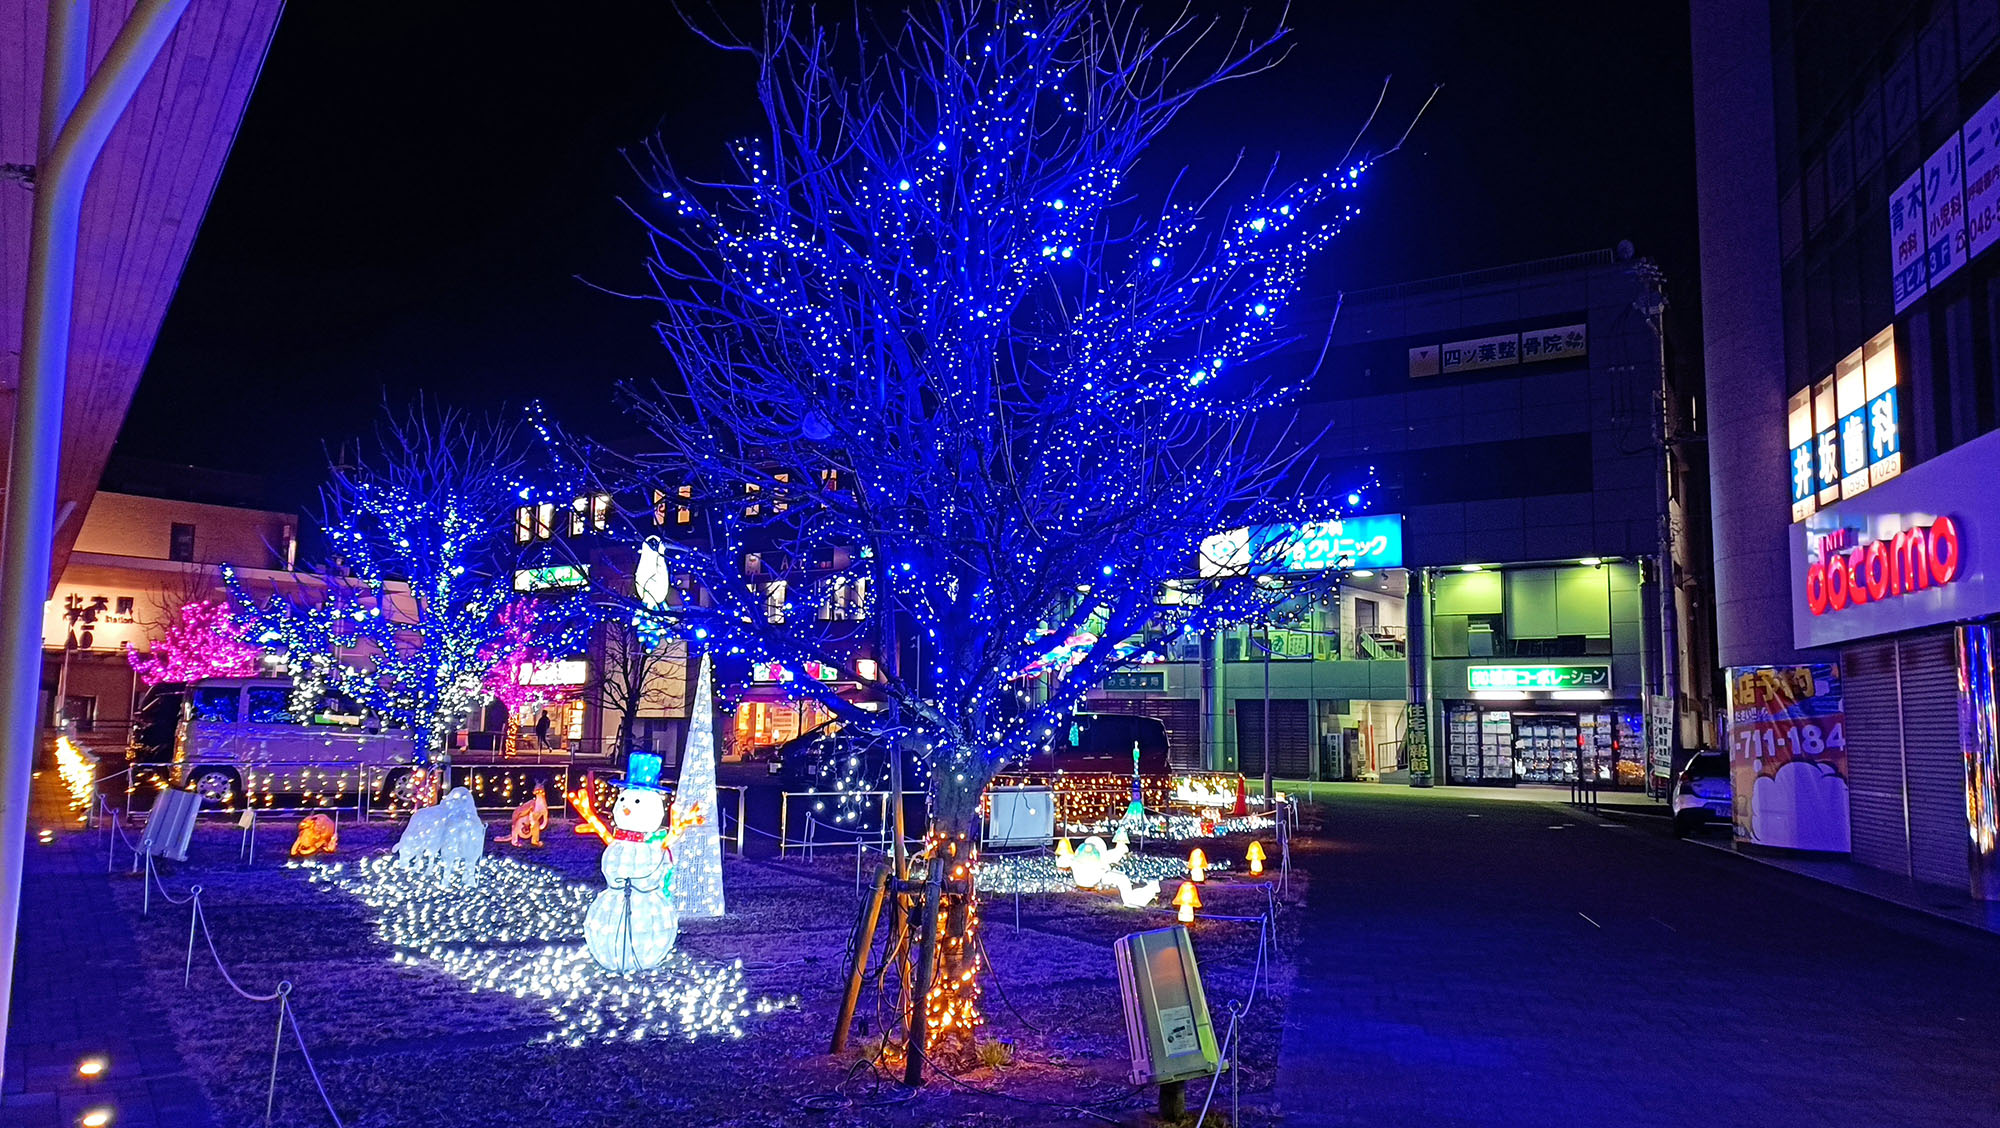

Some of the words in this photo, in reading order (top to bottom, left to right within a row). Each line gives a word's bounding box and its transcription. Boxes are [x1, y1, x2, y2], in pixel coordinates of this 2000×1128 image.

[1930, 191, 1961, 238] 小児科
[1444, 334, 1562, 367] 四ツ葉整骨院
[1793, 392, 1896, 500] 井坂歯科
[1807, 516, 1958, 616] docomo
[1408, 704, 1429, 772] 住宅情報館
